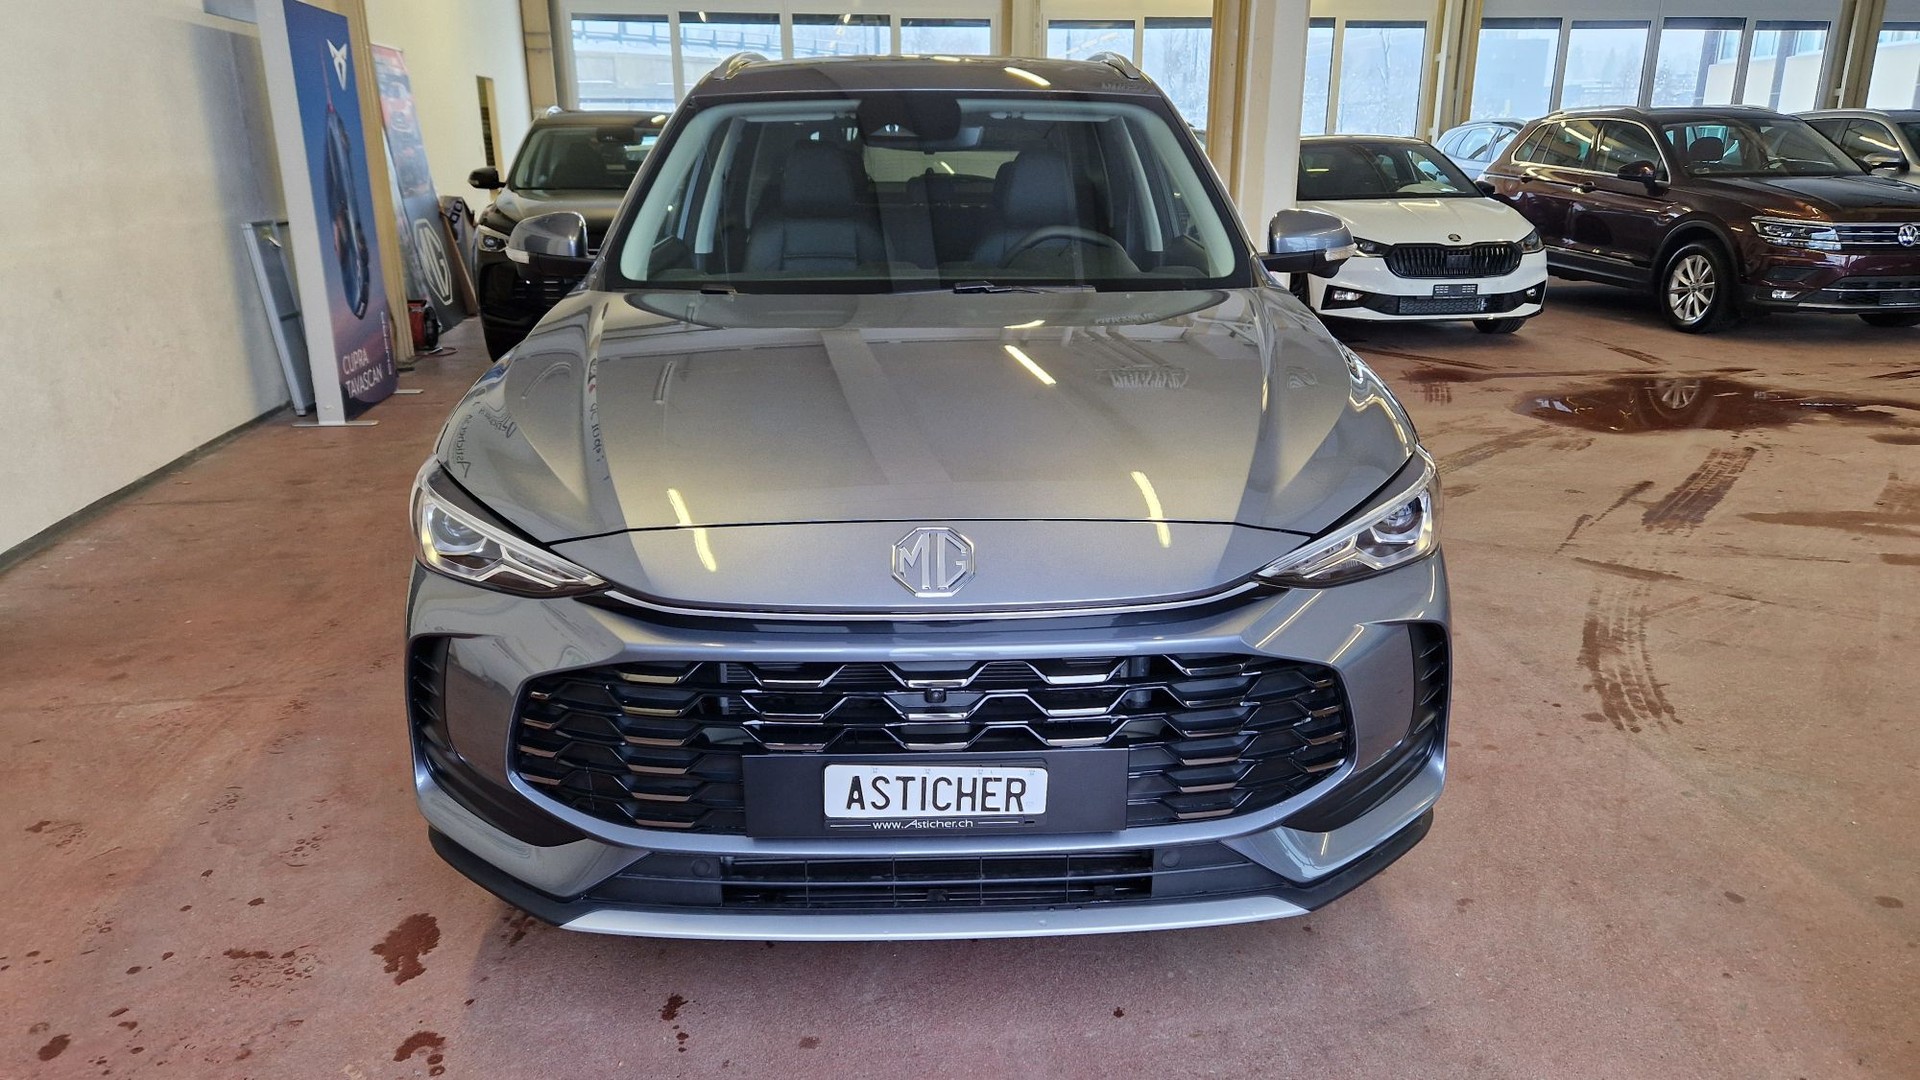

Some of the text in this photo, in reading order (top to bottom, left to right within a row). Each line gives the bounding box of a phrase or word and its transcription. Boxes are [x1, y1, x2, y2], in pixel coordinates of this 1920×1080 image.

[416, 226, 450, 299] MG
[343, 348, 369, 375] CUPRA
[345, 364, 382, 398] TAVASCAN
[898, 531, 969, 592] MG
[845, 775, 1027, 812] ASTICHER
[872, 818, 974, 830] www.Asticher.ch
